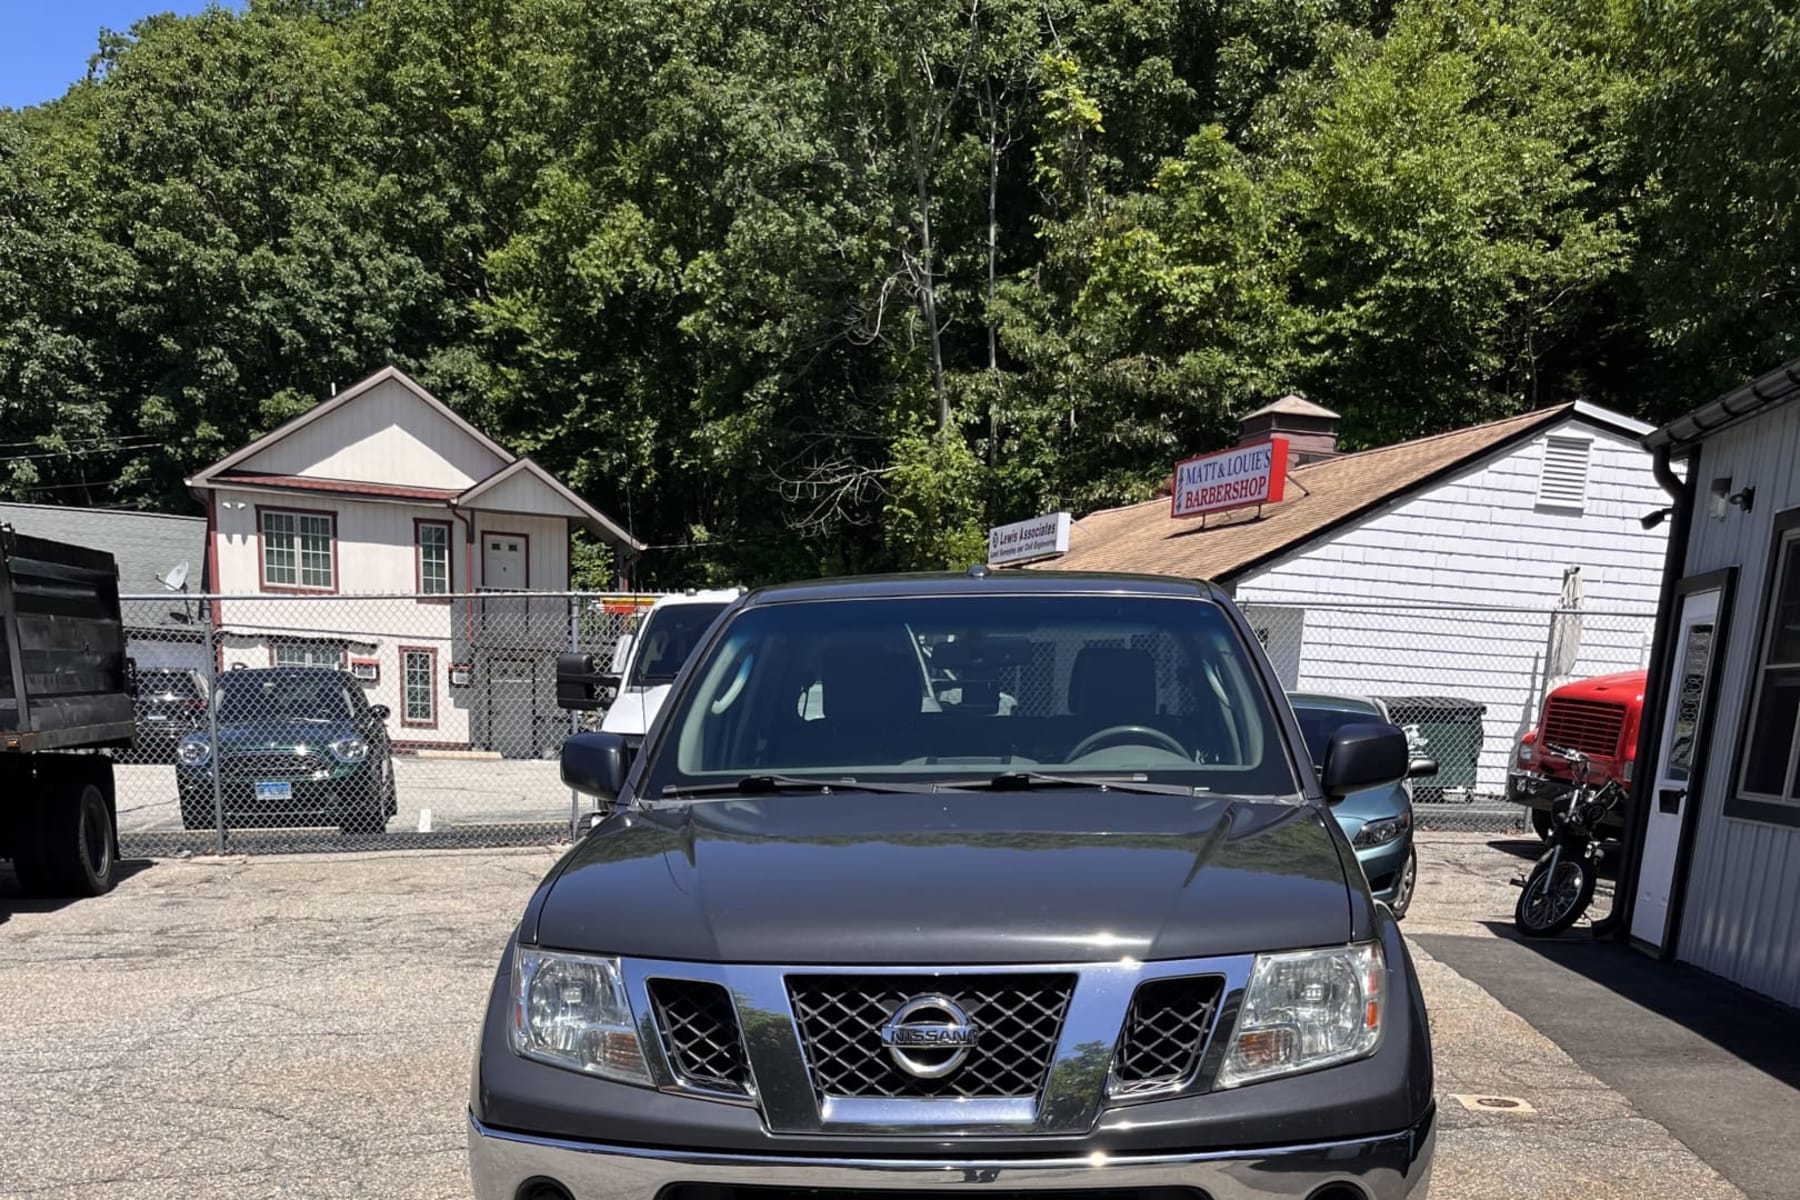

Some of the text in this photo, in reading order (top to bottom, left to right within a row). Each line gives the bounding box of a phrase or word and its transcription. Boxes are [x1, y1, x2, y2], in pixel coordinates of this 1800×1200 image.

[1186, 448, 1271, 485] MATT & LOUIE'S
[1185, 475, 1267, 509] BARBERSHOP
[1000, 522, 1056, 545] Lewis Associates
[891, 1030, 967, 1042] NISSAN
